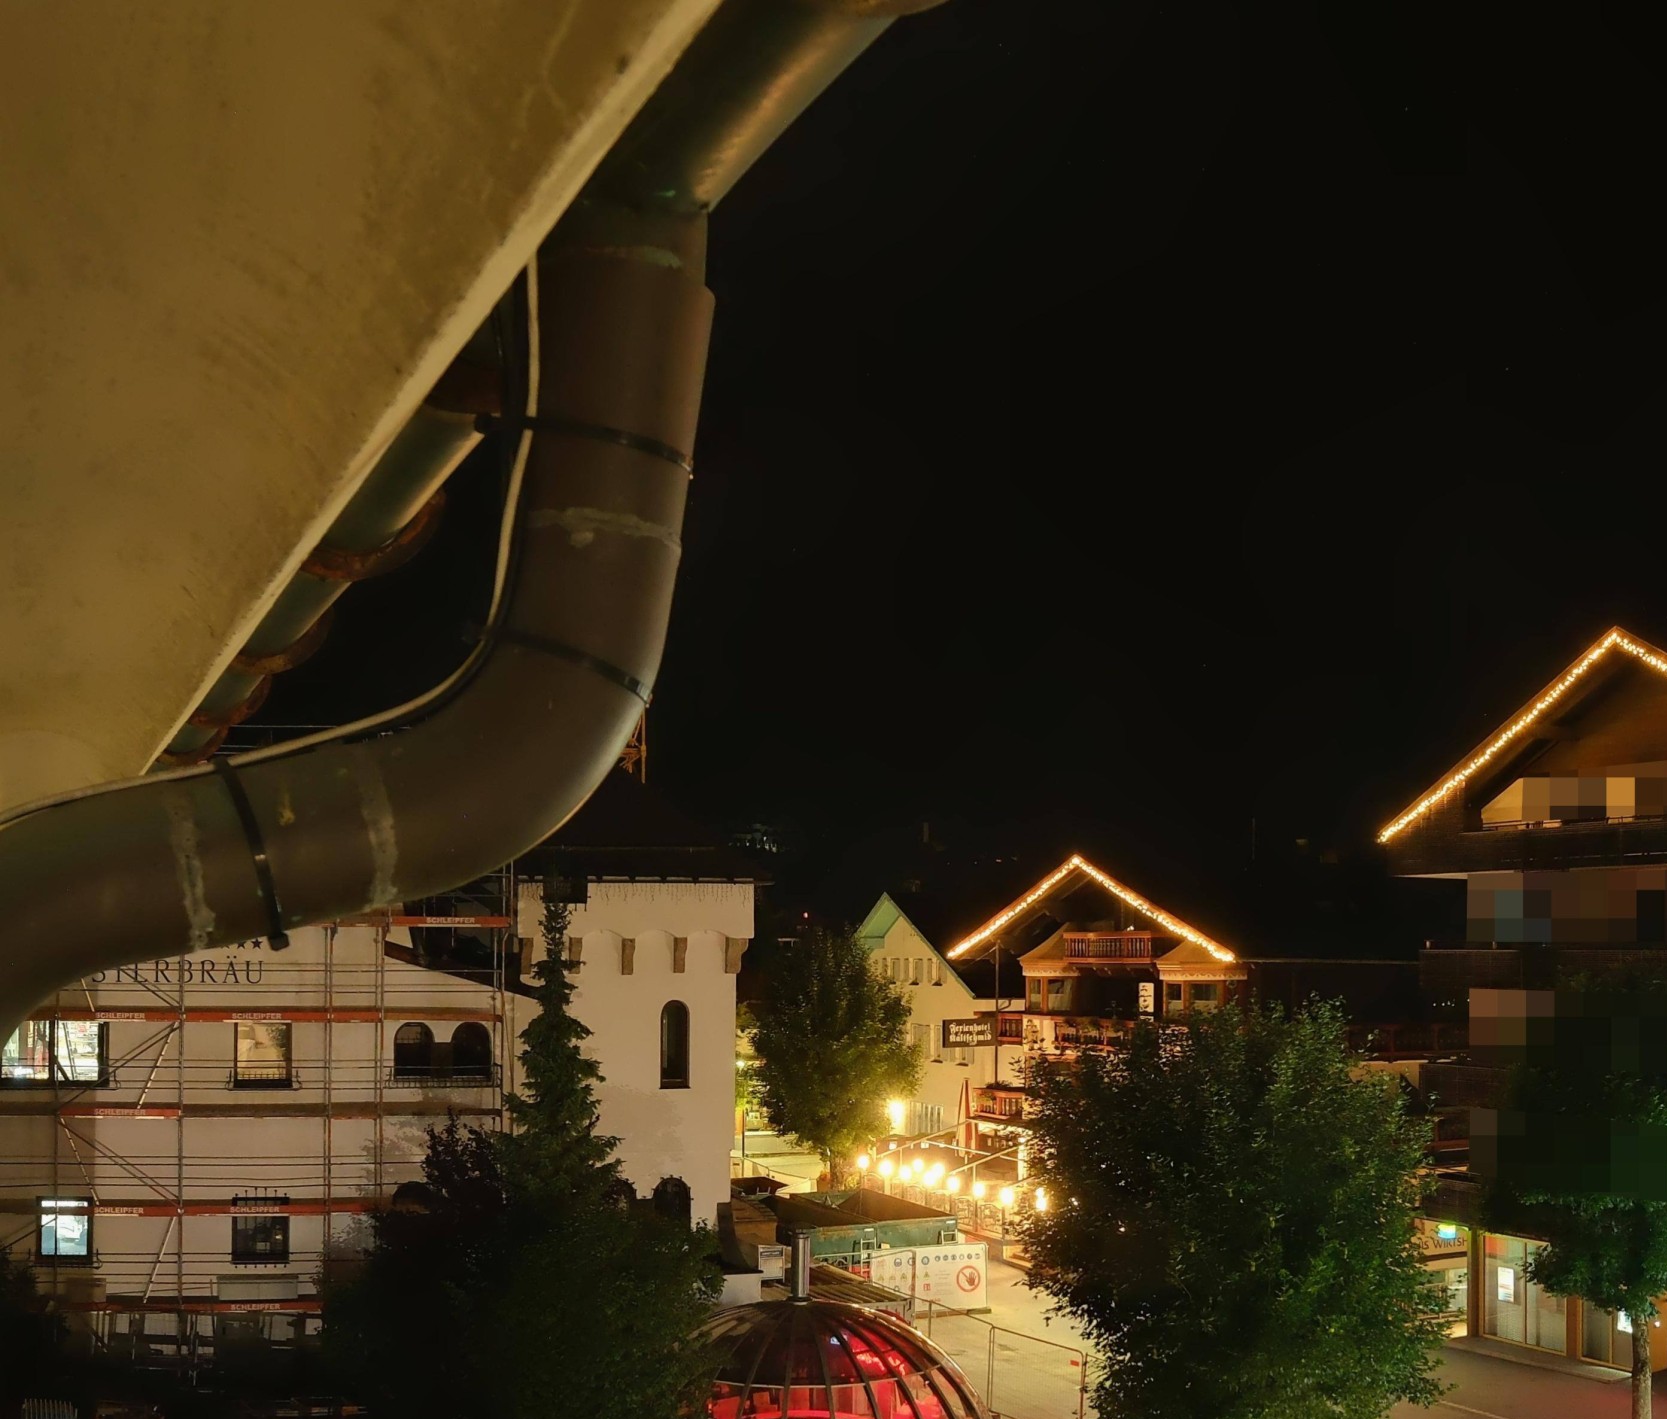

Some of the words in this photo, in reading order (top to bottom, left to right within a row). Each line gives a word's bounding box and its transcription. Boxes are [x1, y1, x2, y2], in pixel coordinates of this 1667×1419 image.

[425, 916, 476, 926] SCHLEIPFER
[95, 1012, 146, 1021] SCHLEIPFER
[231, 1012, 282, 1021] SCHLEIPFER
[93, 1108, 146, 1117] SCHLEIPFER
[94, 1206, 144, 1215] SCHLEIPFER
[229, 1205, 280, 1214] SCHLEIPFER
[230, 1303, 280, 1312] SCHLEIPFER
